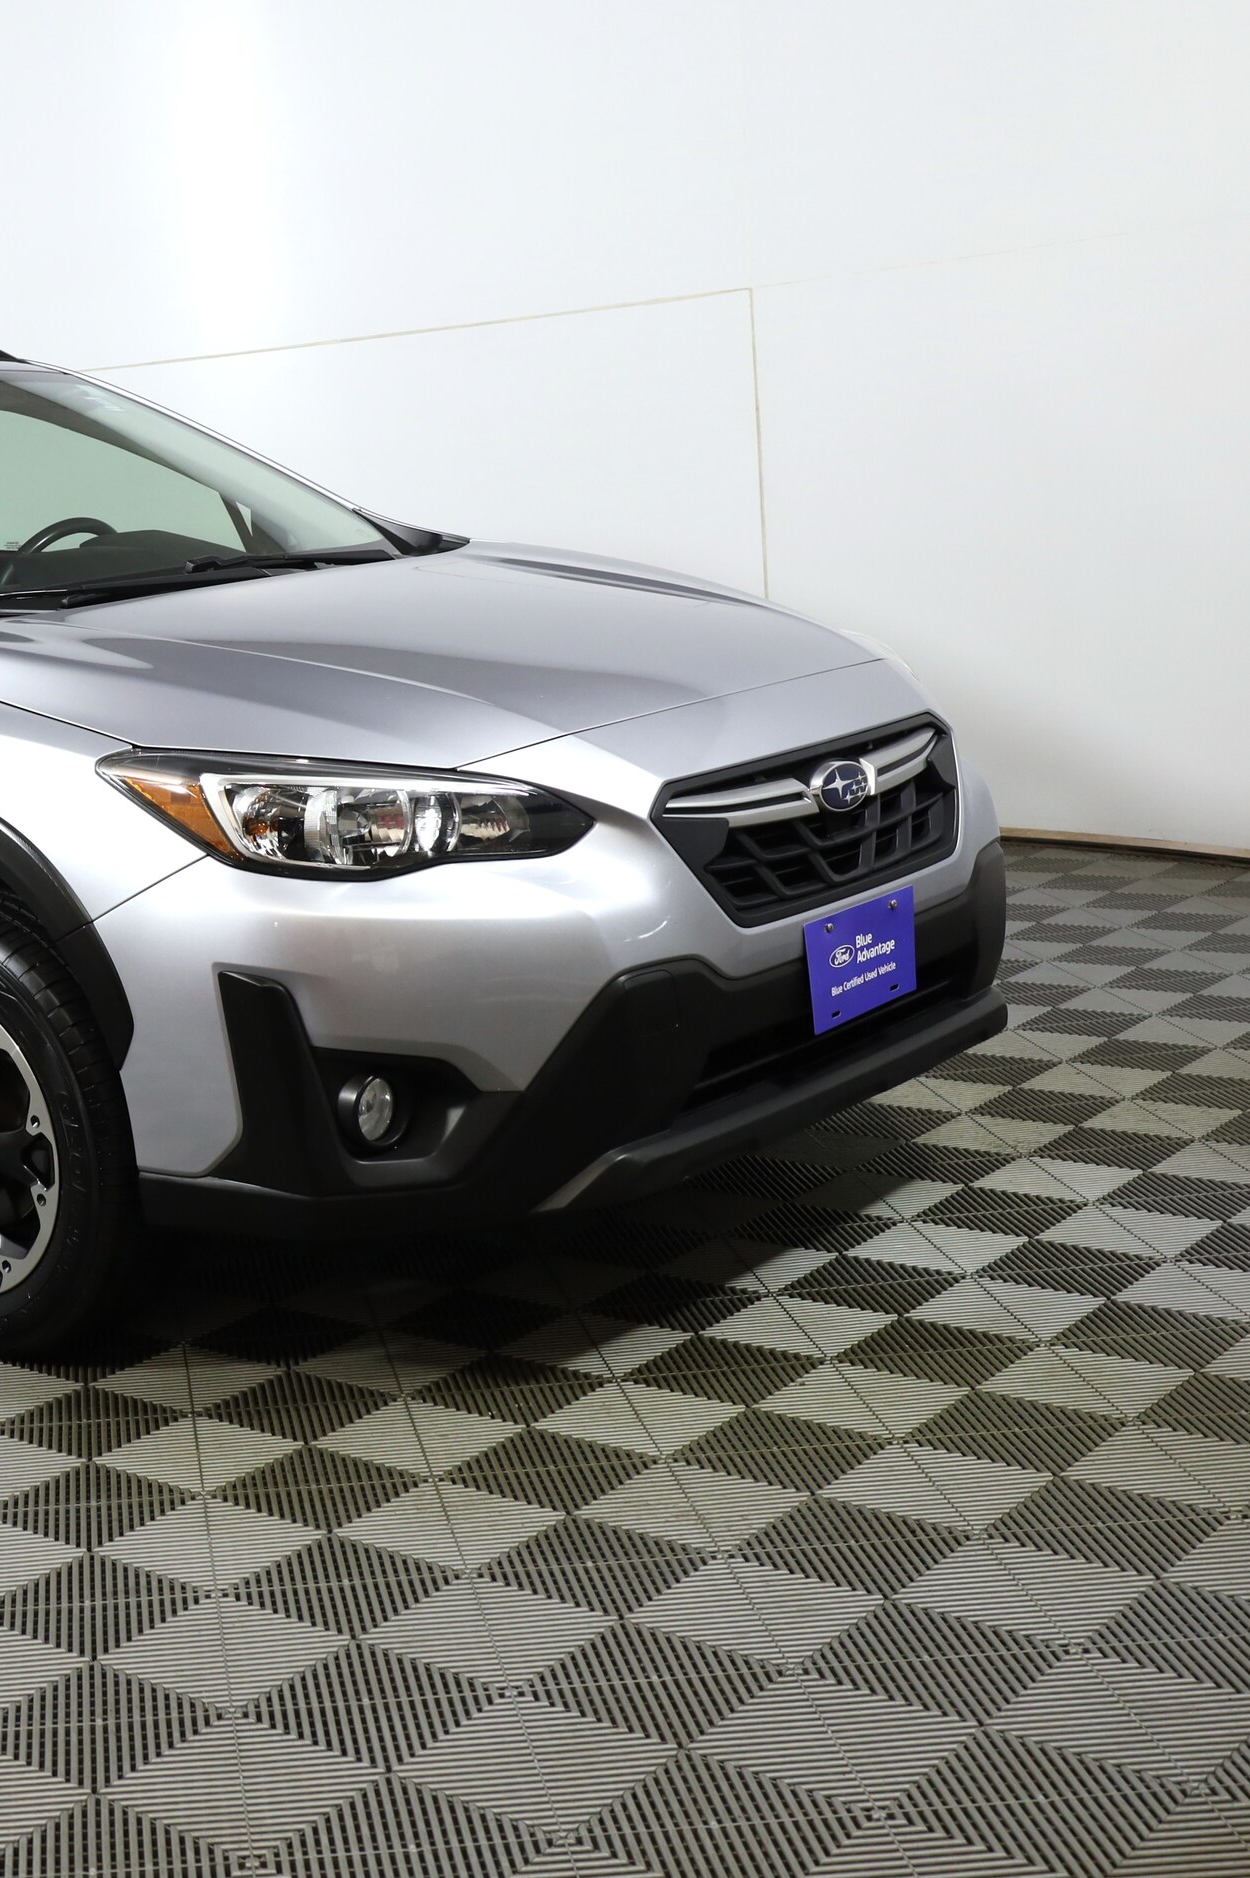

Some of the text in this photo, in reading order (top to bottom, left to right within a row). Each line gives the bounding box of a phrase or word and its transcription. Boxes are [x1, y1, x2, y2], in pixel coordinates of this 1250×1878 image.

[855, 932, 873, 949] Blue
[856, 939, 896, 964] Advantage
[831, 961, 897, 997] Blue Certified Used Vehicle
